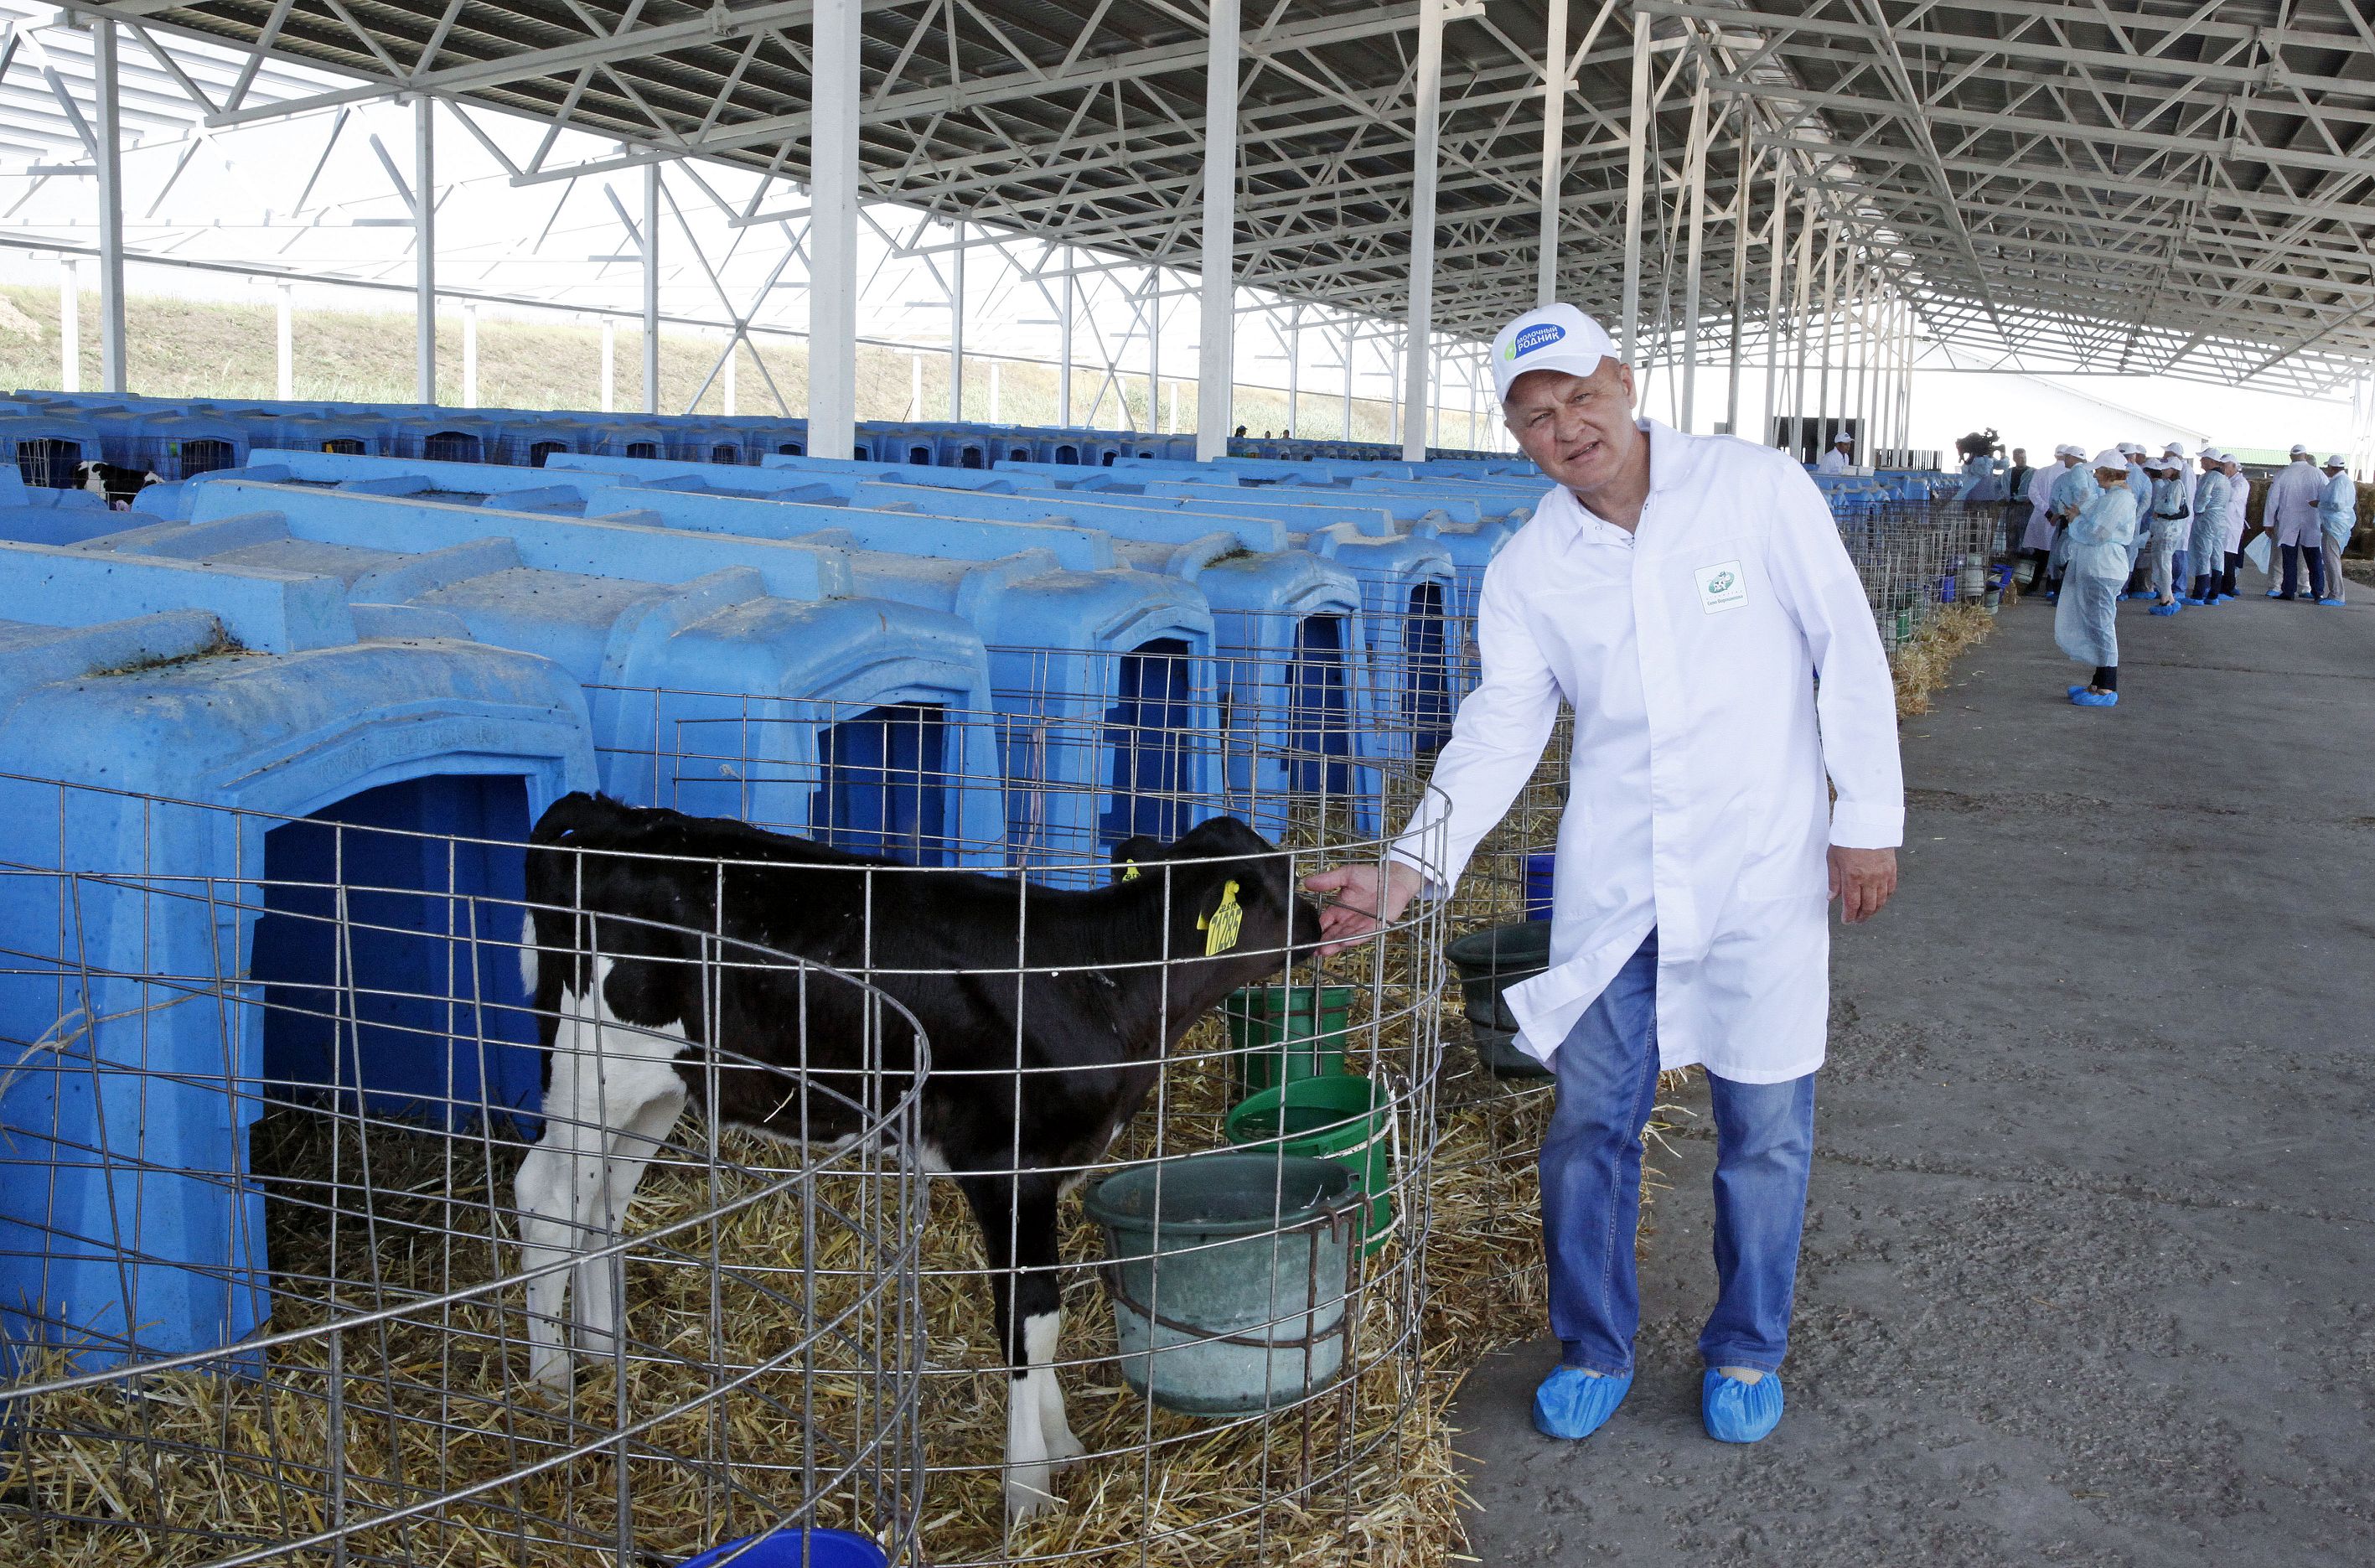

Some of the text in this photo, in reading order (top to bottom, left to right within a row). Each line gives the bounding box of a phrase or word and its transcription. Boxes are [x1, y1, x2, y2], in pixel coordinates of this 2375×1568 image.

[1517, 325, 1558, 344] МОЛОЧНЫЙ
[1518, 332, 1560, 351] РОДНИК
[1209, 908, 1242, 955] 71285
